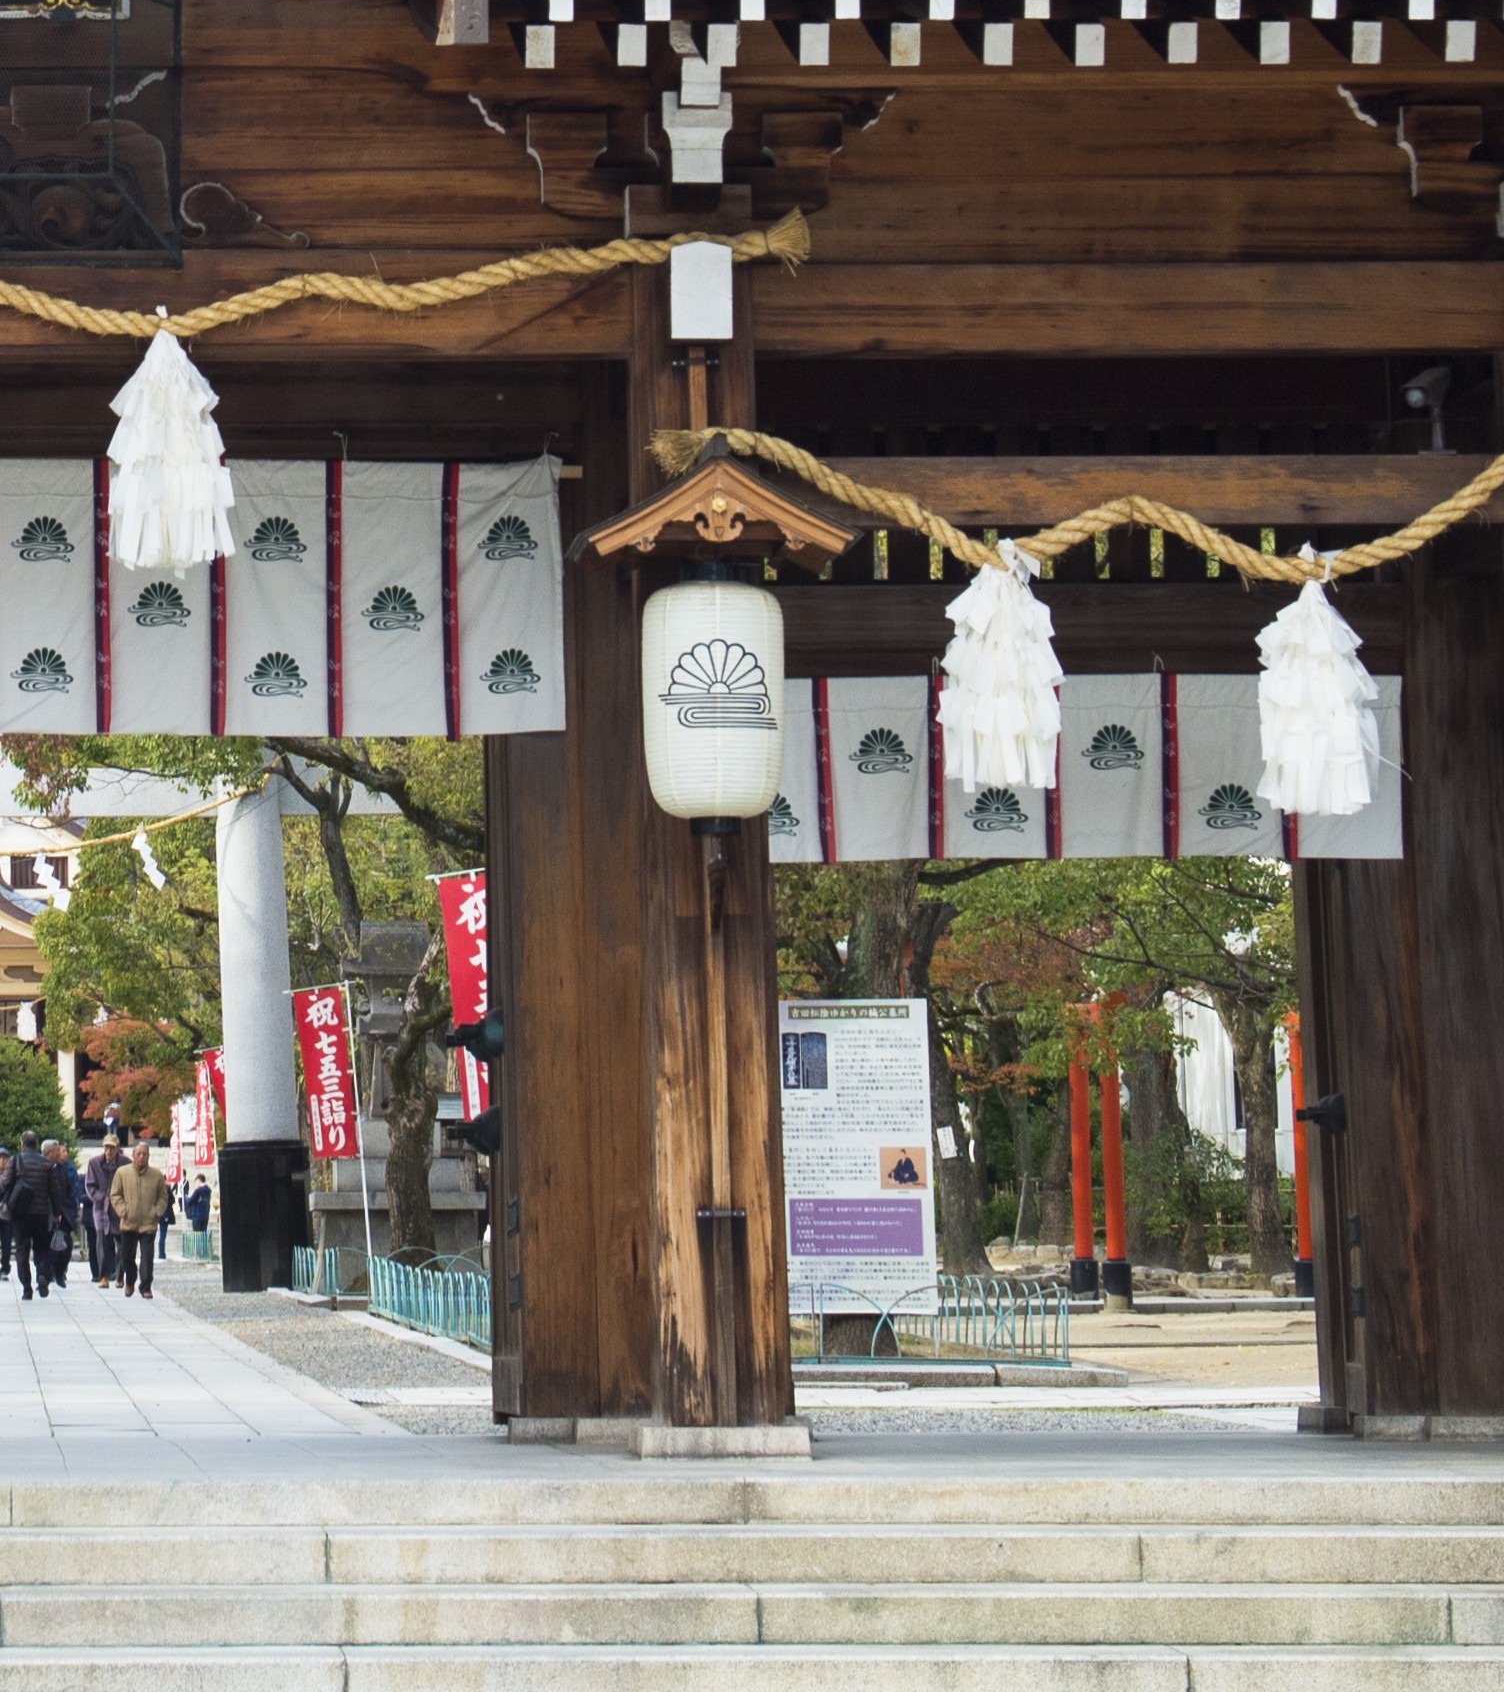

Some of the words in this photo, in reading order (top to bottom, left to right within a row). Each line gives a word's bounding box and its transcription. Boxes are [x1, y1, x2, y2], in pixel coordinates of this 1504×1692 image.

[305, 995, 347, 1152] 祝七五三詣り
